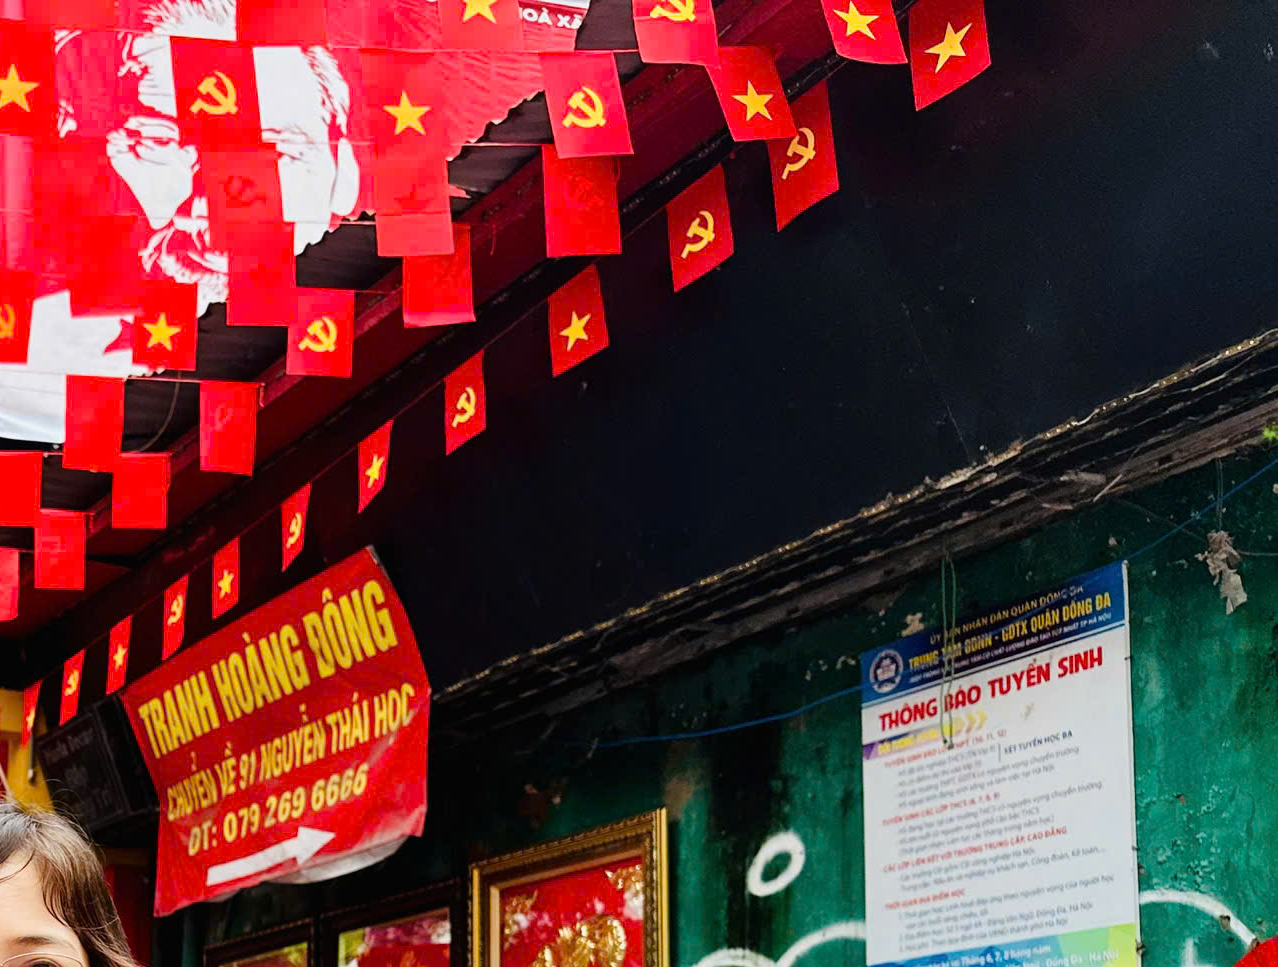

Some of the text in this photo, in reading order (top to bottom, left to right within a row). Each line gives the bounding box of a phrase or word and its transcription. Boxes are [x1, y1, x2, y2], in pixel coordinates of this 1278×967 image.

[519, 7, 553, 25] OÀ
[1001, 619, 1027, 642] GDTX
[1030, 605, 1059, 635] QUẬN
[1062, 592, 1092, 622] ĐỐNG
[138, 670, 220, 758] TRANH
[212, 632, 311, 722] HOÀNG
[879, 698, 938, 731] THÔNG
[944, 684, 981, 713] BÁO
[988, 658, 1051, 699] TUYỂN
[1058, 647, 1103, 678] SINH
[167, 683, 415, 822] CHUYỂN VỀ 91 NGUYỄN THÁI HỌC
[223, 803, 260, 842] 079
[264, 787, 305, 828] 269
[311, 763, 369, 811] 6666
